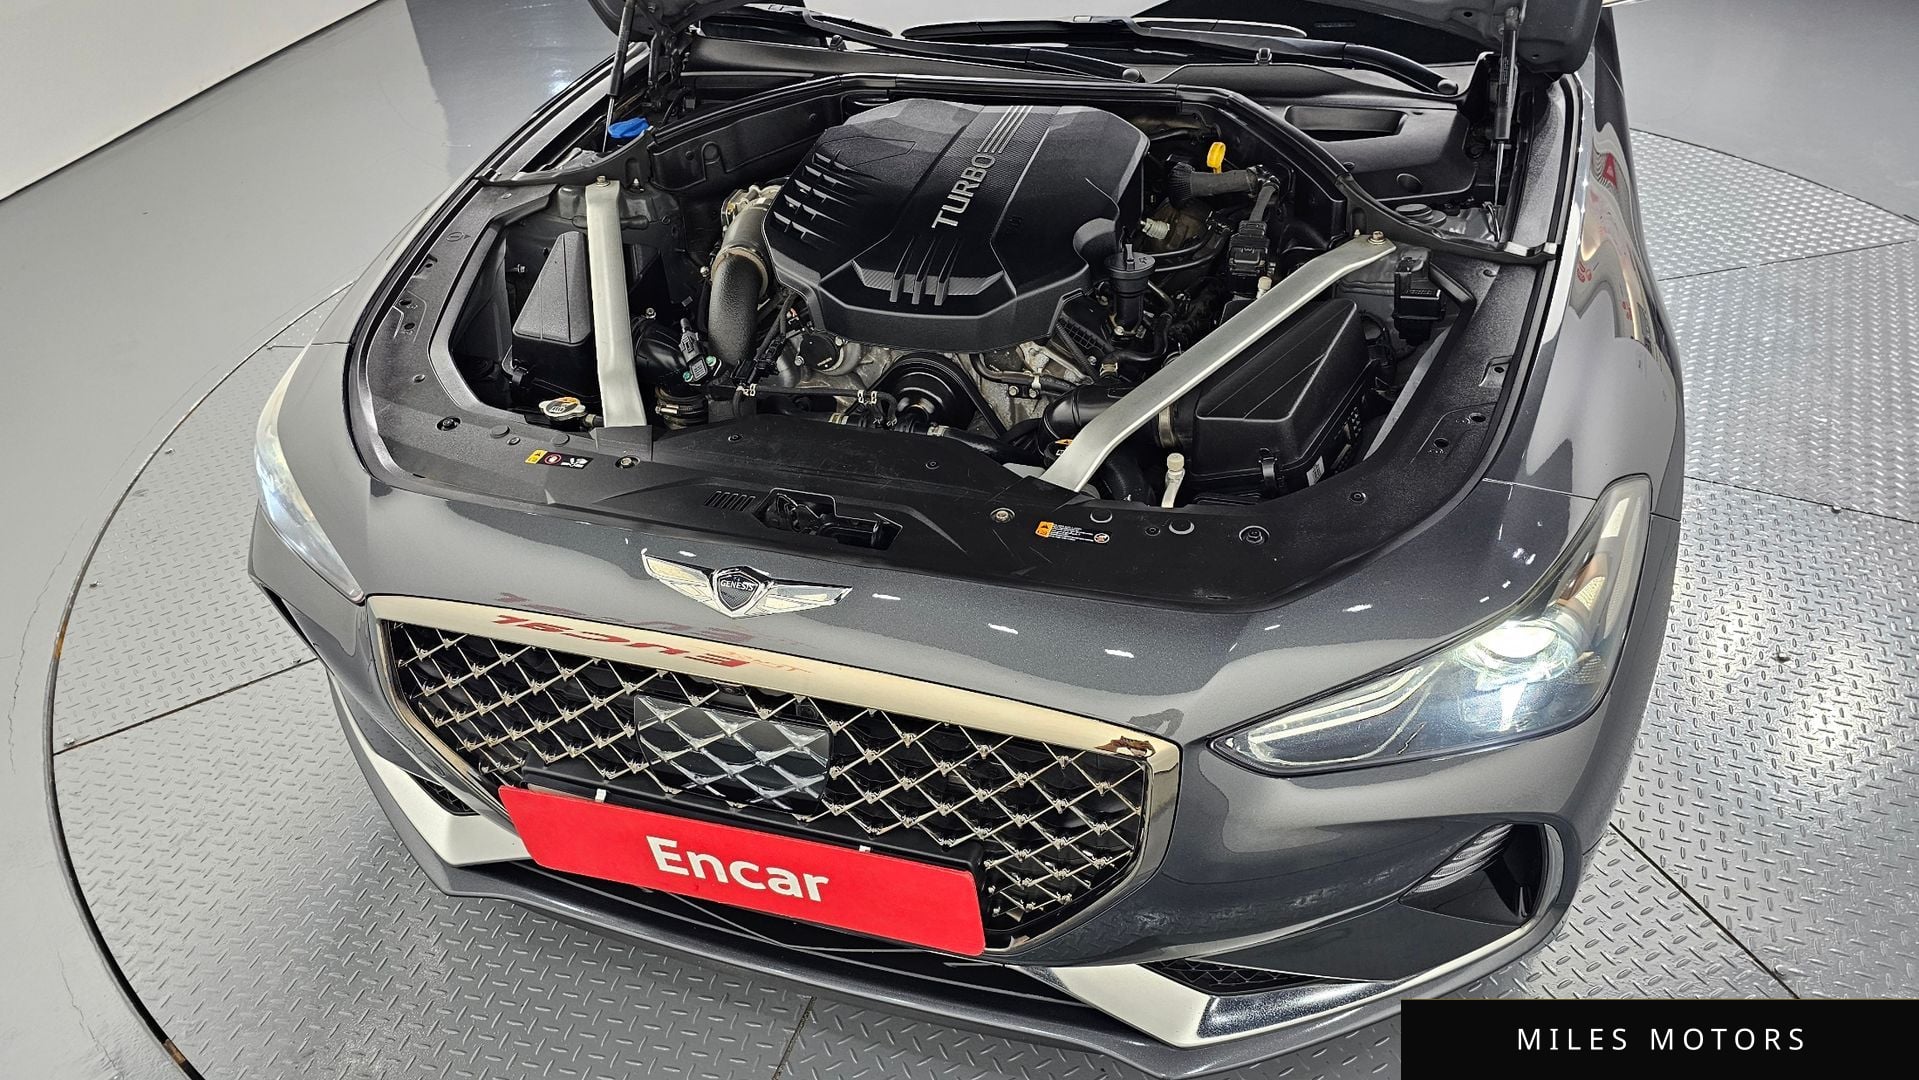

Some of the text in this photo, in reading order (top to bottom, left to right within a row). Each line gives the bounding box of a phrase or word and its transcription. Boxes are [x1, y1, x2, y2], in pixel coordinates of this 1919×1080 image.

[931, 153, 996, 229] TURBO
[720, 579, 755, 591] GENESIS
[645, 835, 830, 902] Encar
